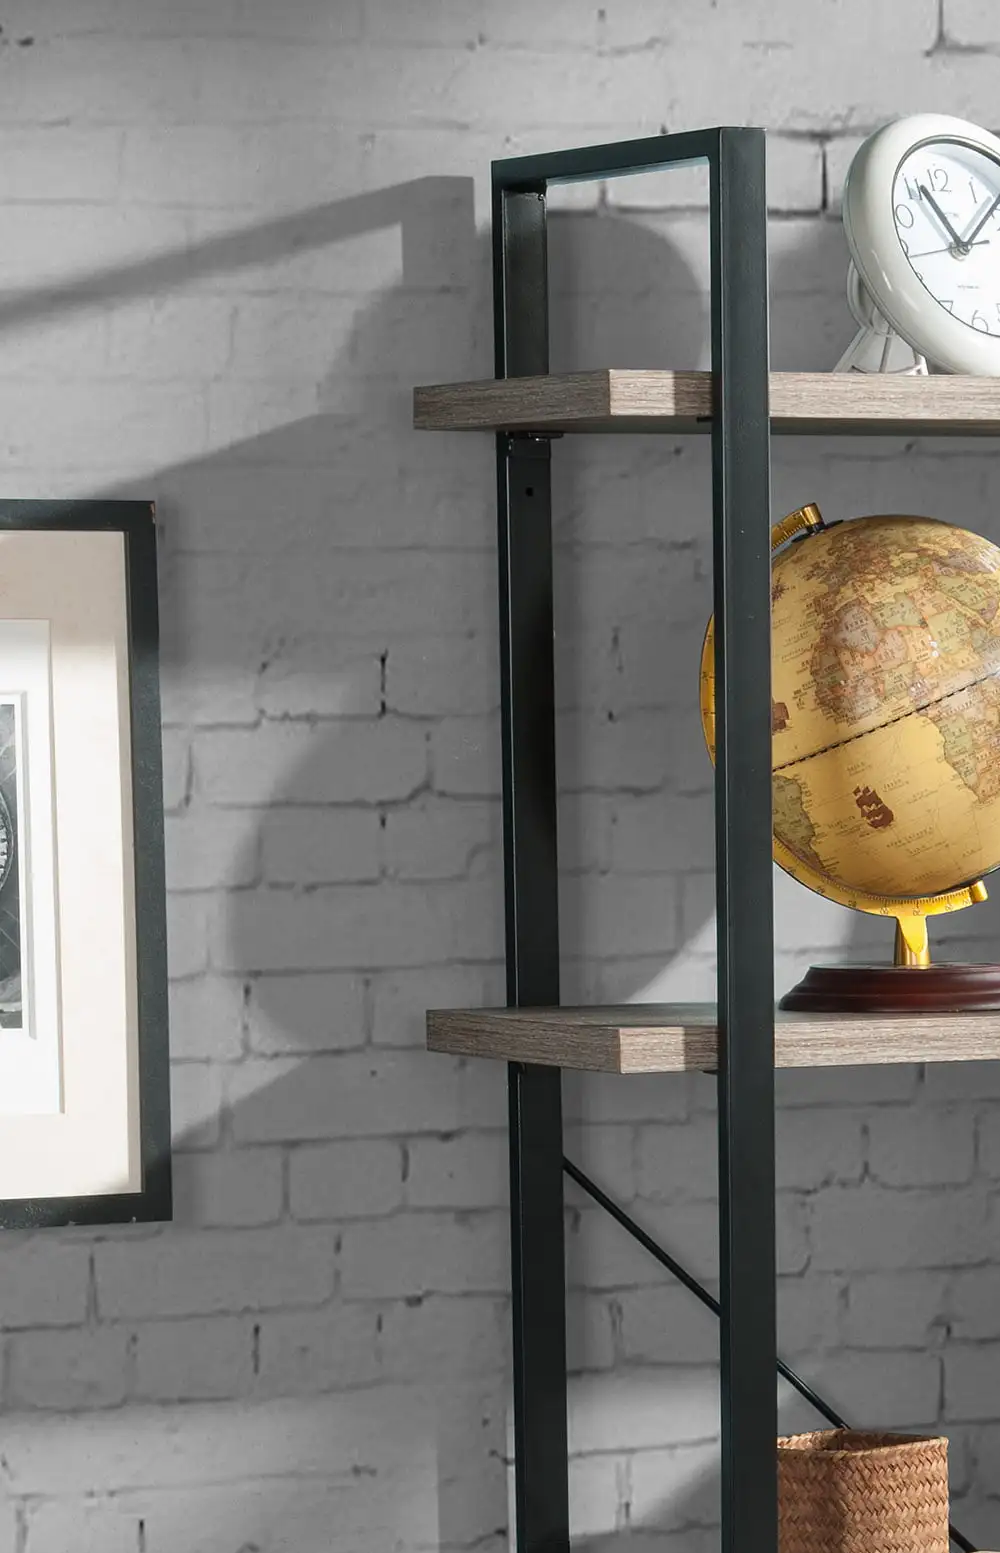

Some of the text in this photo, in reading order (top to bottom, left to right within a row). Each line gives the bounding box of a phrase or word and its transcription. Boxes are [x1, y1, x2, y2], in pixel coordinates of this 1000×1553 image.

[926, 168, 952, 193] 12
[968, 180, 978, 204] 1
[971, 309, 989, 333] 6
